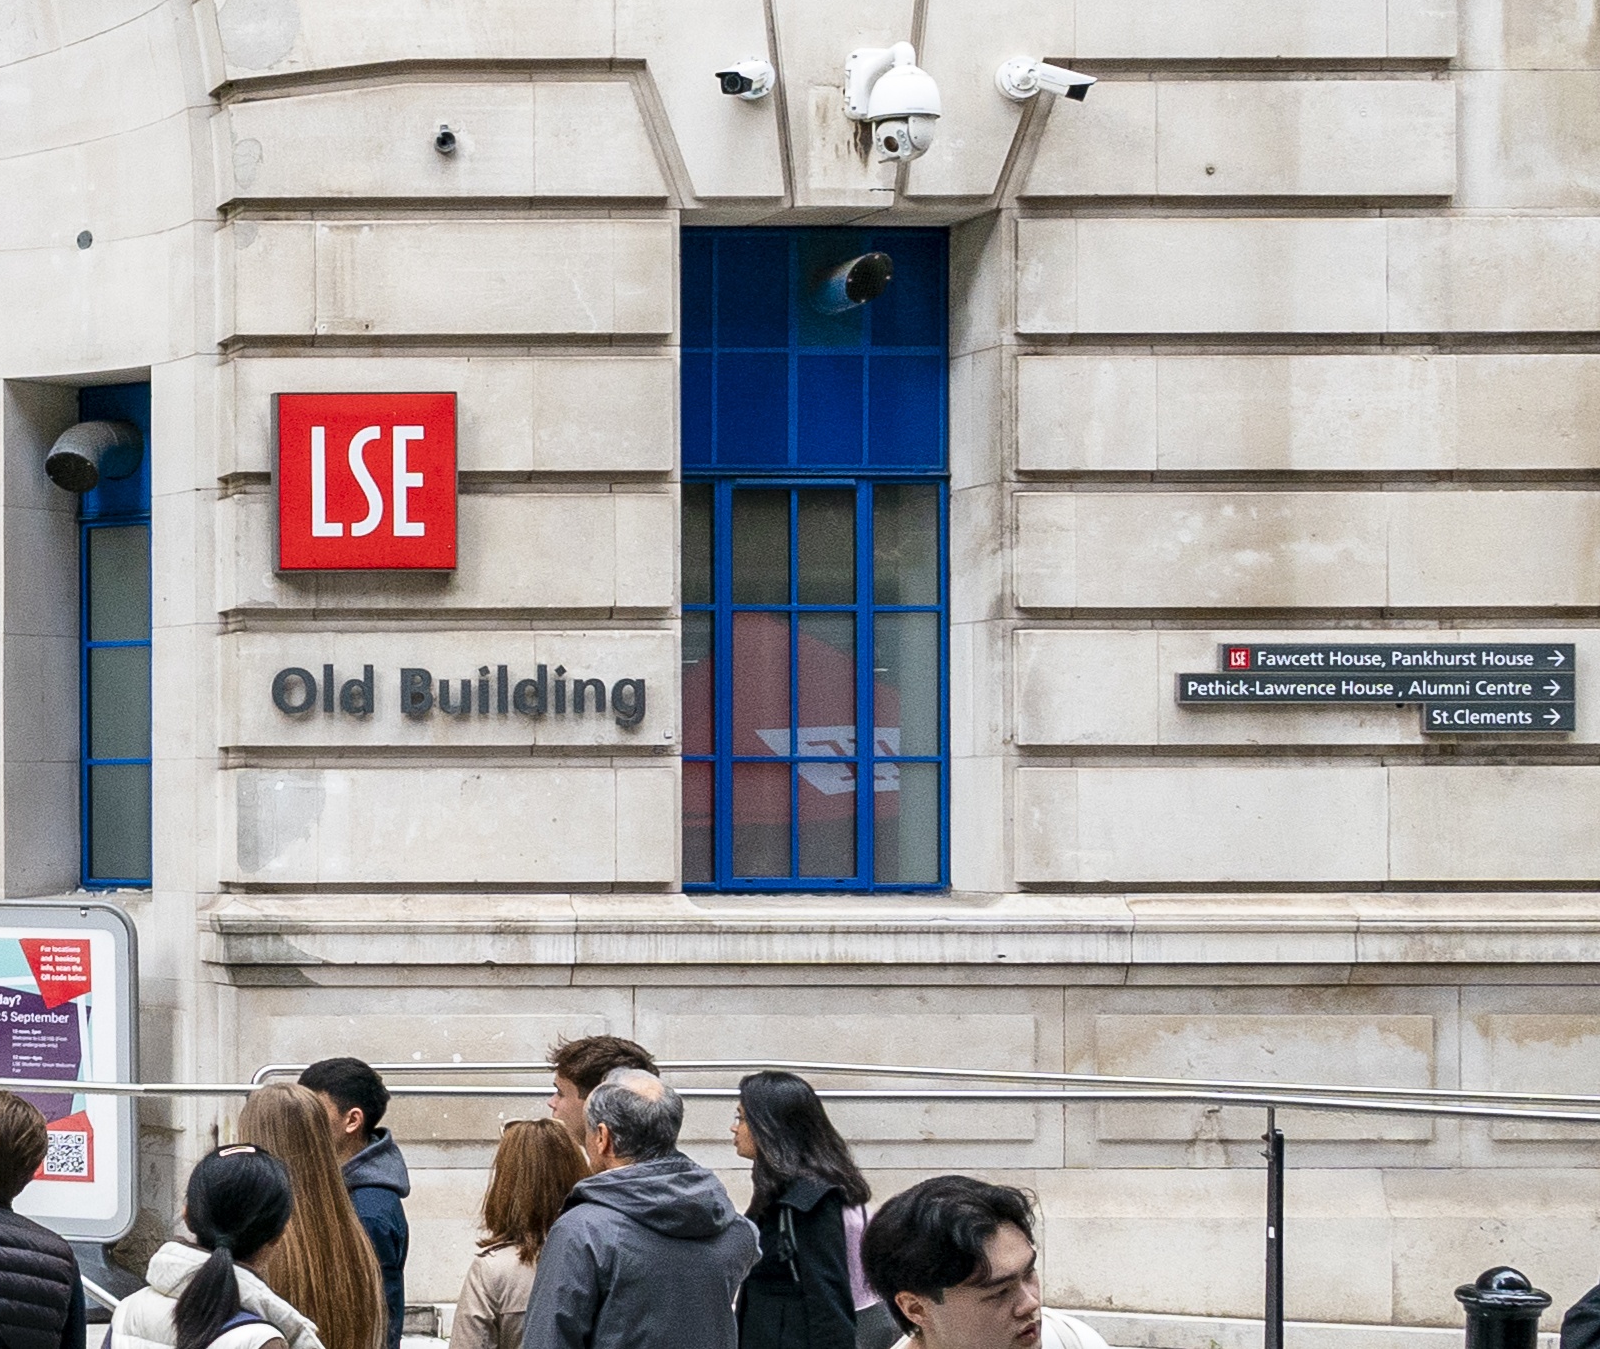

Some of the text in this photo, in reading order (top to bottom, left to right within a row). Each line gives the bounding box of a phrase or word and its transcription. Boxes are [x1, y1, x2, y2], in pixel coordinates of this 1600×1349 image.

[310, 425, 426, 538] LSE
[1229, 651, 1534, 668] LSE Fawcett House, Pankhurst House
[271, 663, 647, 728] Old Building
[1187, 680, 1337, 696] Pethick-Lawrence
[1341, 680, 1394, 696] House
[1408, 680, 1471, 696] Alumni
[1475, 680, 1533, 696] Centre
[1432, 709, 1533, 725] St.Clements
[10, 1012, 70, 1025] September
